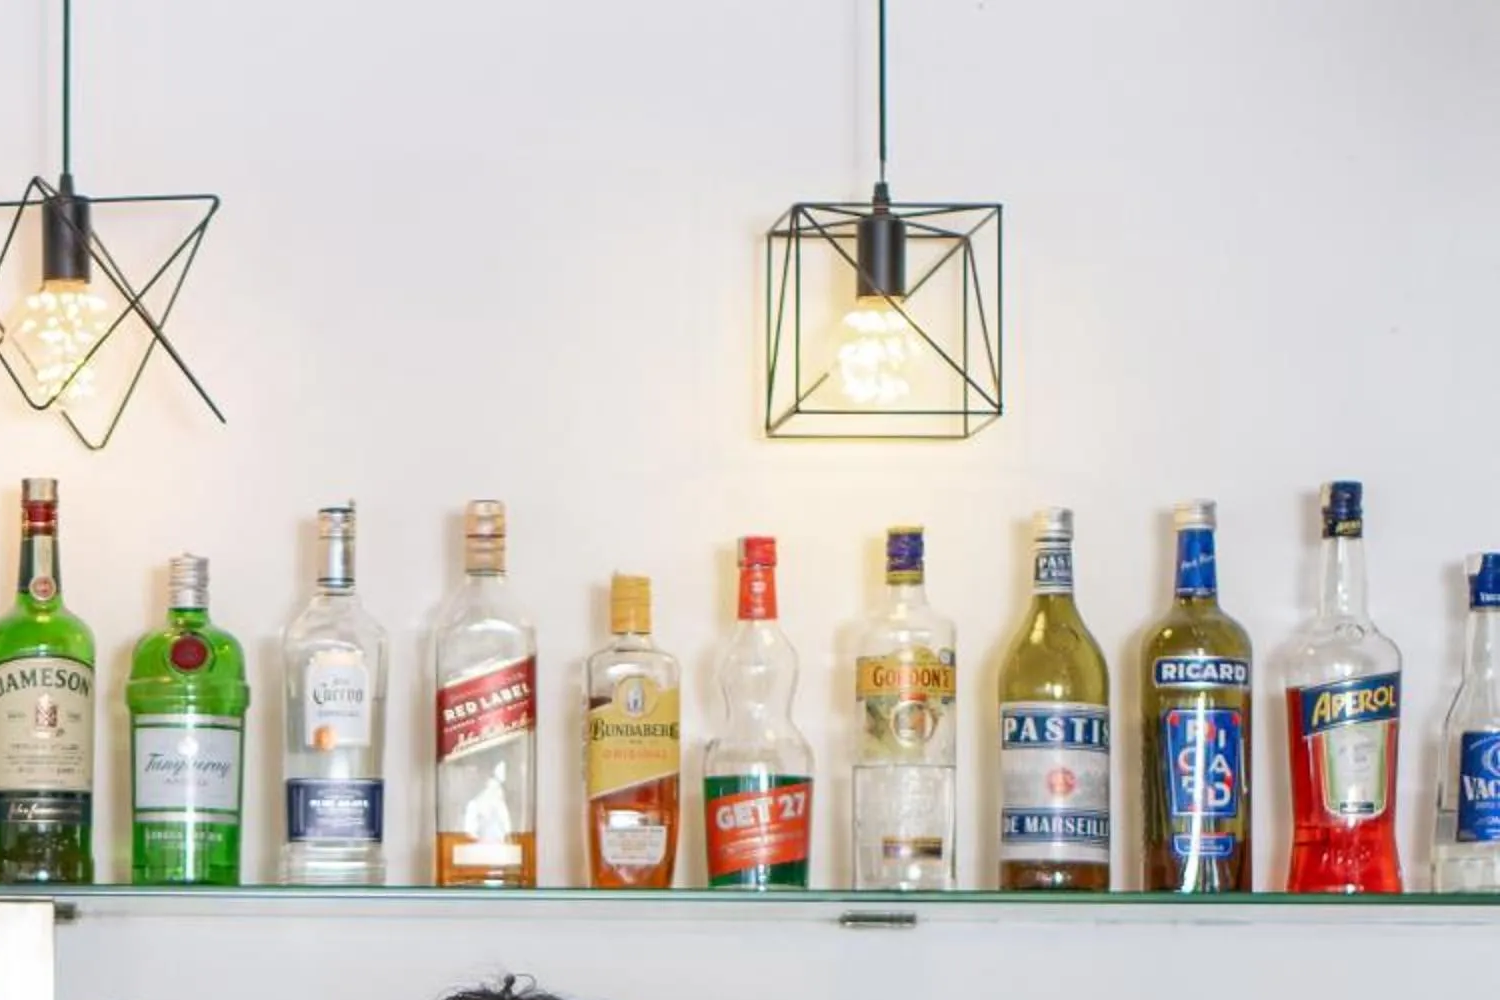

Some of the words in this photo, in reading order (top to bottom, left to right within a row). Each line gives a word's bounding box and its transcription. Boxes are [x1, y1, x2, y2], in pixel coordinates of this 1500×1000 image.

[1160, 662, 1247, 682] RICARD
[443, 701, 478, 721] RED
[479, 682, 530, 711] LABEL
[1311, 685, 1397, 725] APEROL
[144, 753, 232, 779] Tanqeray
[716, 796, 774, 831] GET
[778, 790, 807, 819] 27
